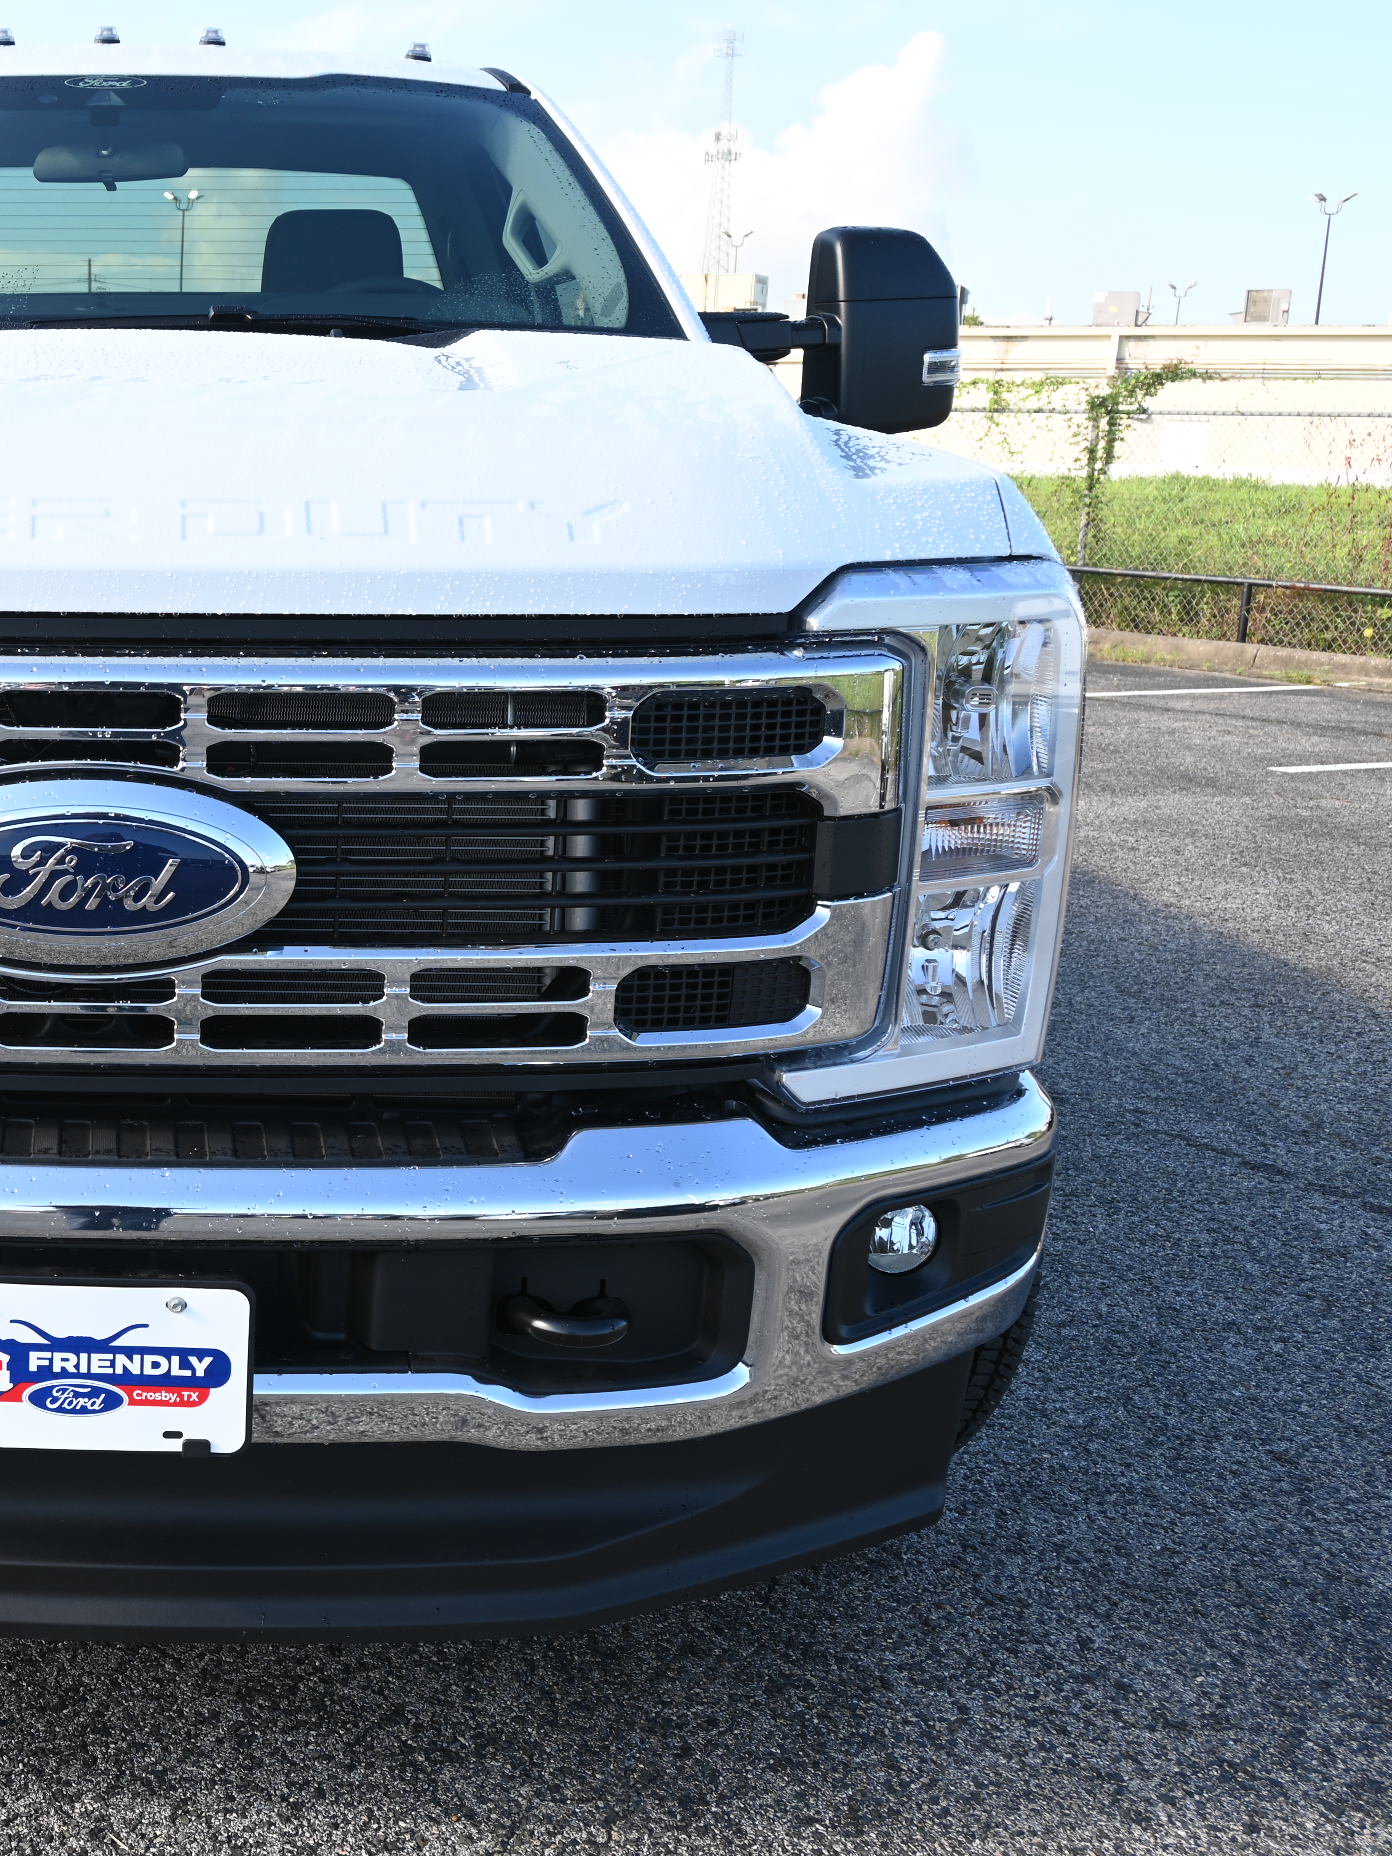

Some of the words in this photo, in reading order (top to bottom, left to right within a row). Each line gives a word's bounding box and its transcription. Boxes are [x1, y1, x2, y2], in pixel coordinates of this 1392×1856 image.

[78, 76, 133, 88] Ford
[178, 498, 634, 545] DUTY
[28, 1350, 214, 1378] FRIENDLY
[45, 1385, 106, 1410] Ford
[132, 1389, 181, 1403] Crosby,
[181, 1391, 200, 1402] TX
